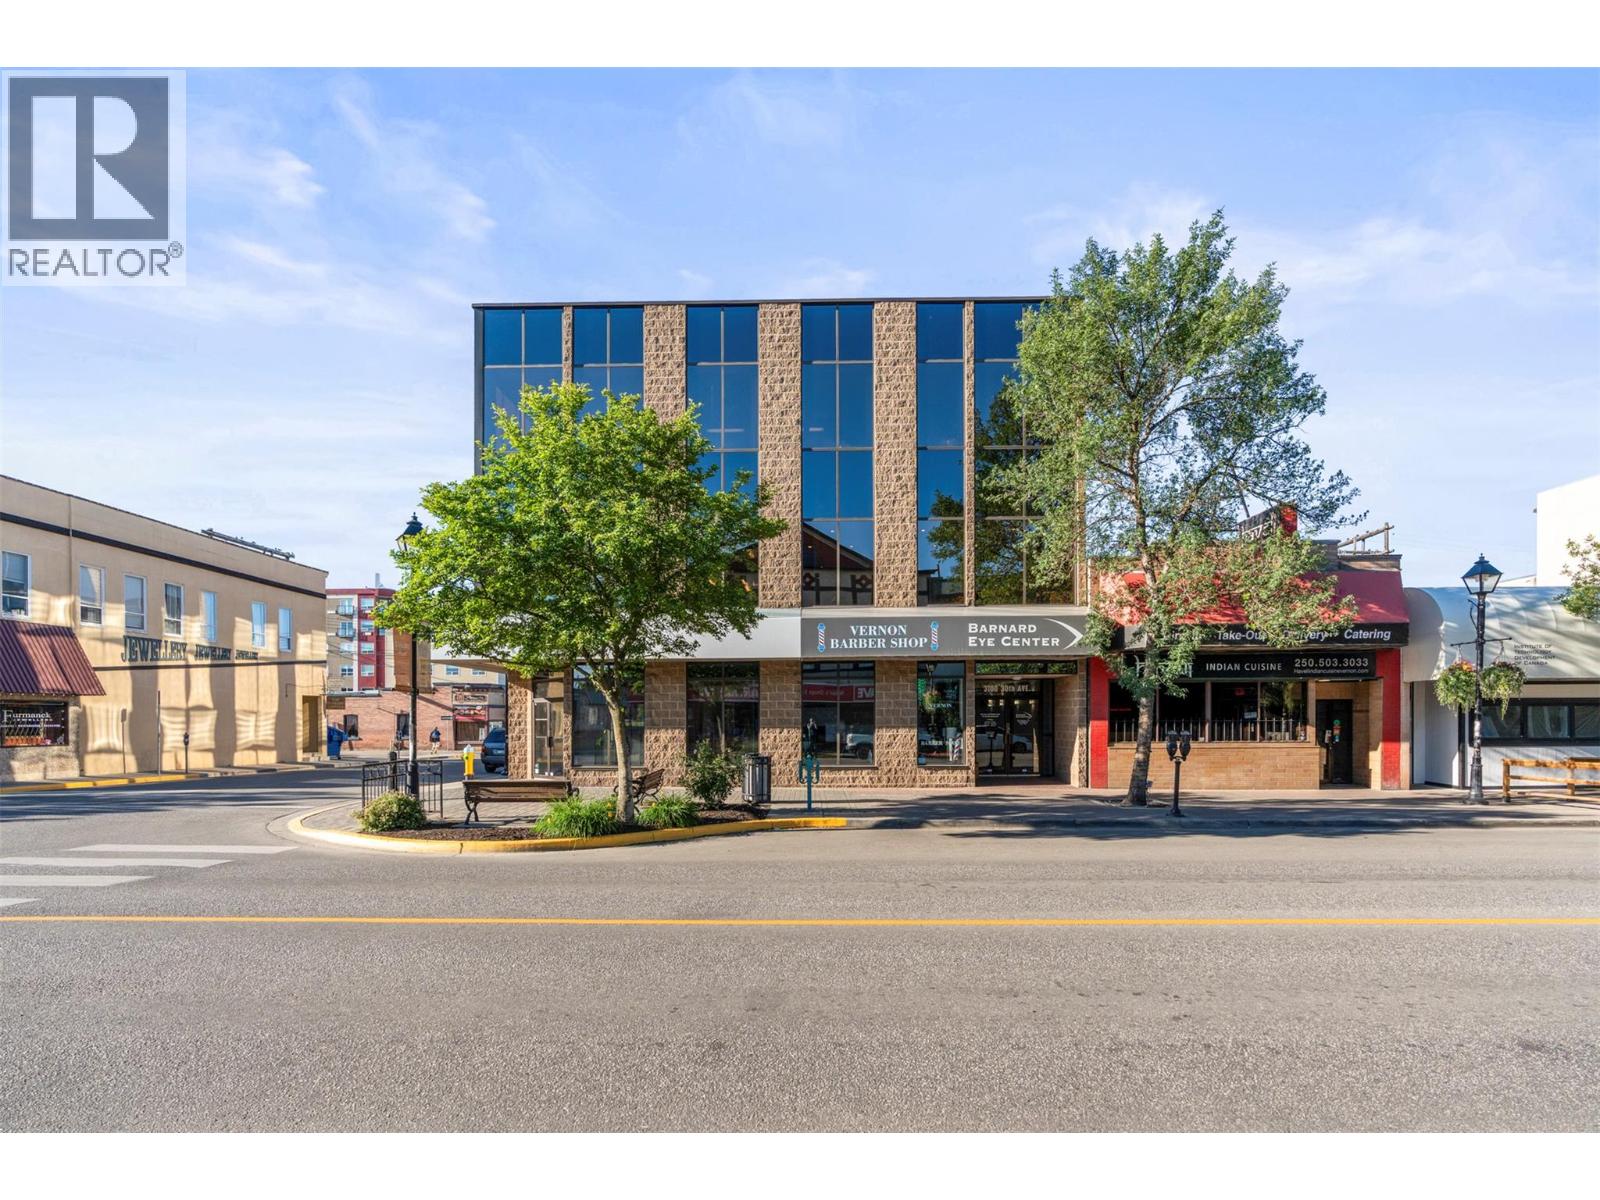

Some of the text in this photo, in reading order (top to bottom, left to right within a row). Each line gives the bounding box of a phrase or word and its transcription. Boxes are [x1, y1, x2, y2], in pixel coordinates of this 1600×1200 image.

[850, 625, 907, 636] VERNON
[968, 623, 1037, 633] BARNARD
[1344, 629, 1392, 640] Catering
[830, 637, 928, 649] BARBER SHOP
[968, 636, 1060, 647] EYE CENTER
[121, 635, 187, 662] JEWELLERY
[1206, 663, 1282, 671] INDIAN CUISINE
[1294, 658, 1369, 667] 250.503.3033
